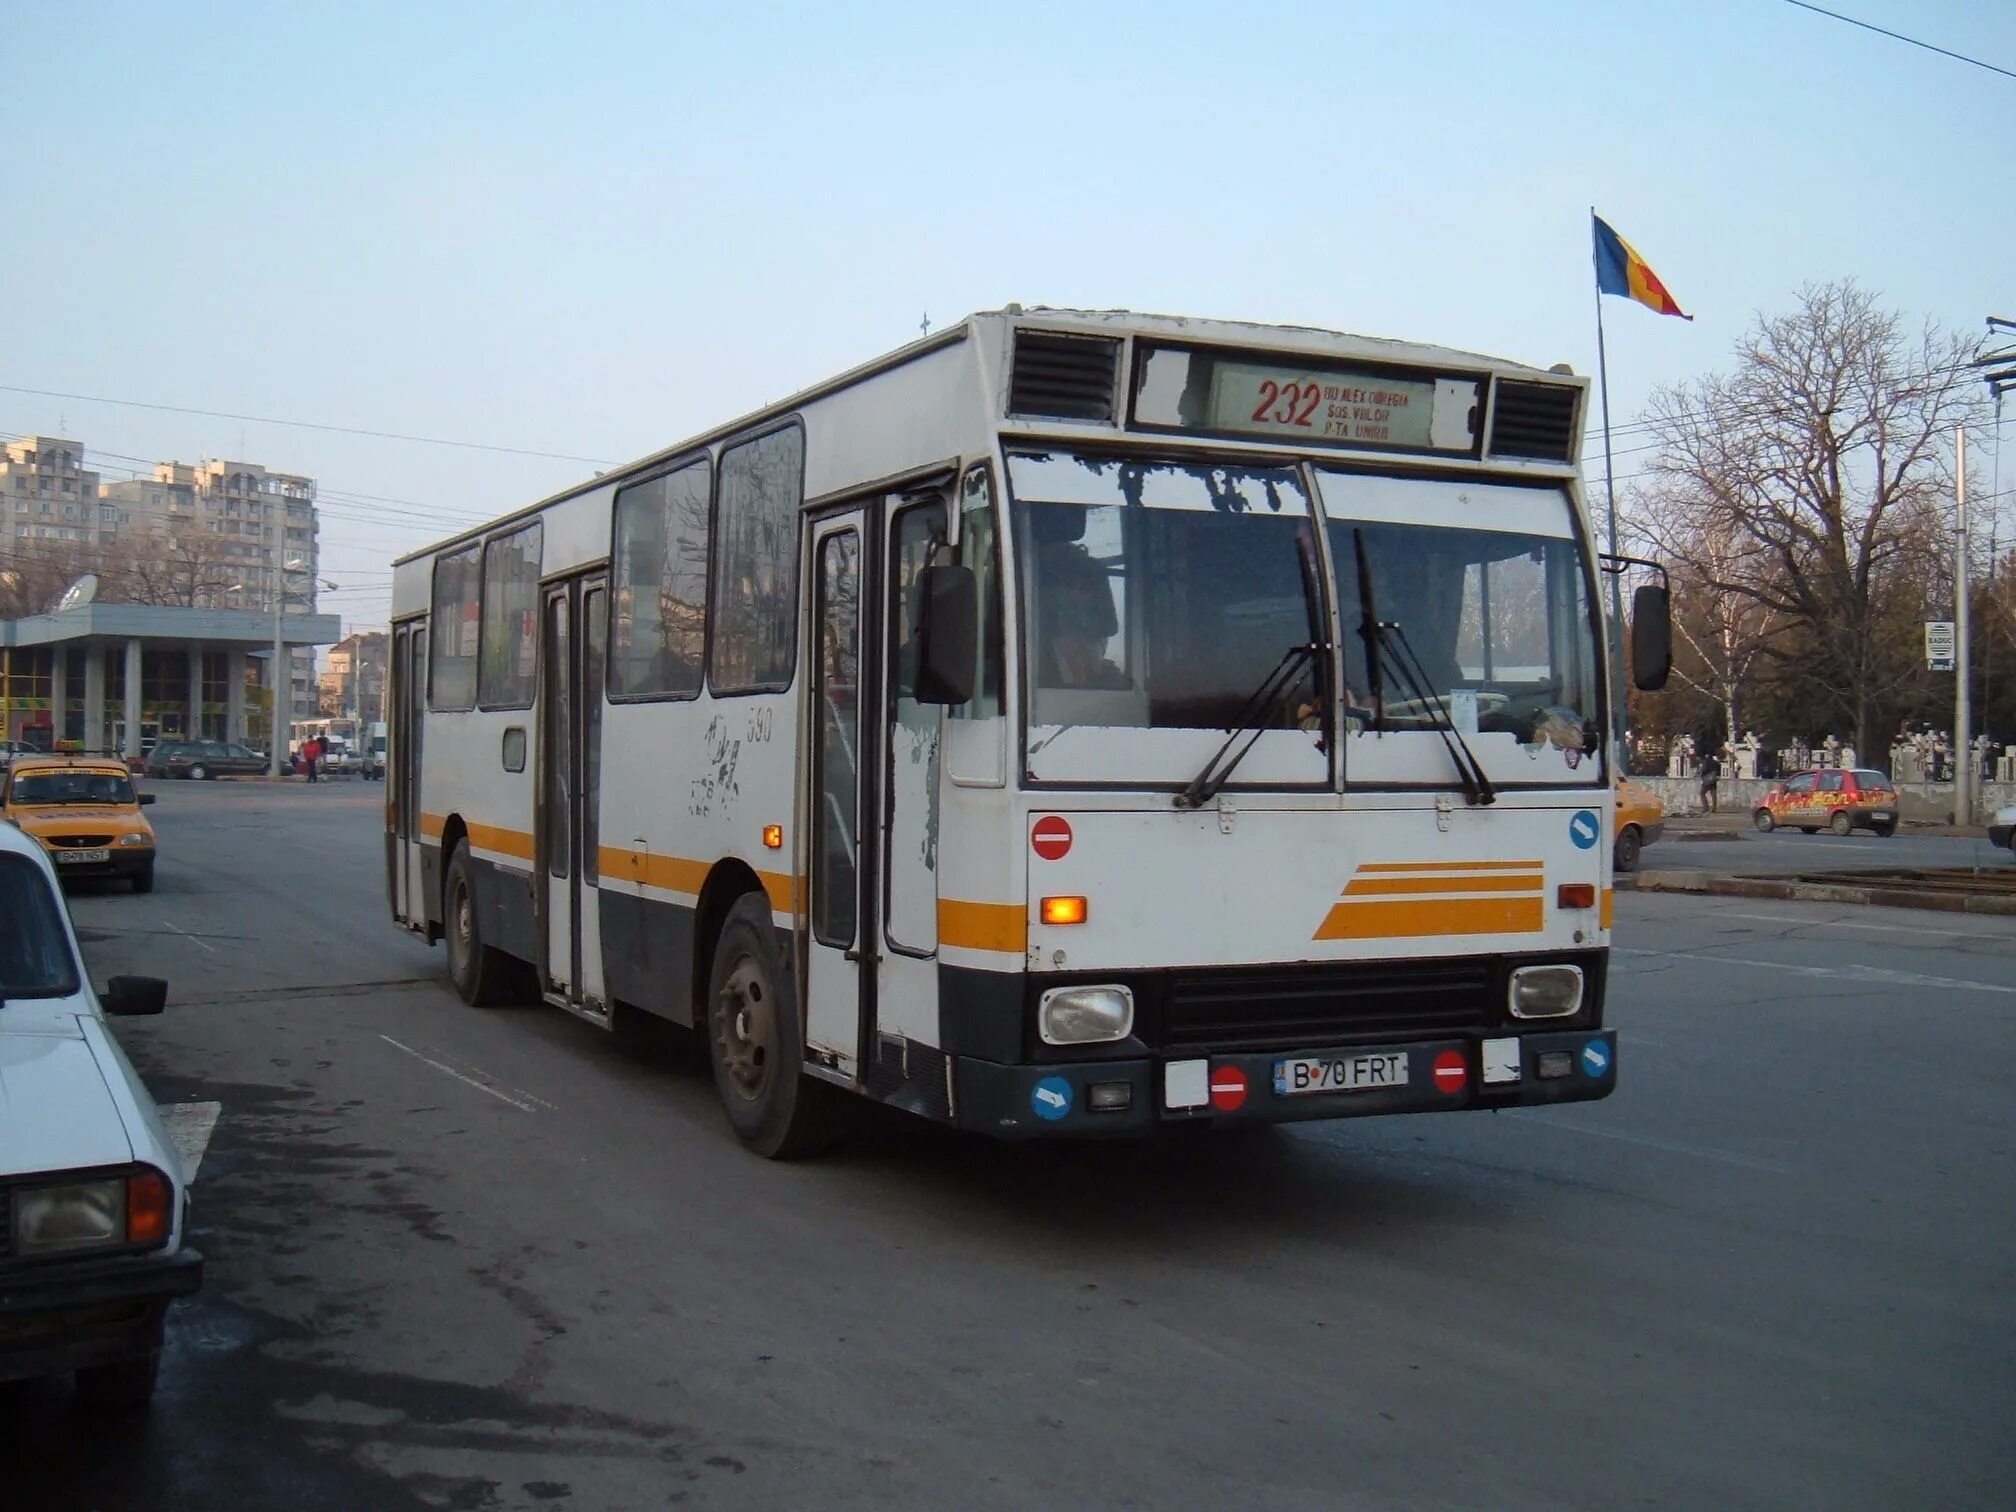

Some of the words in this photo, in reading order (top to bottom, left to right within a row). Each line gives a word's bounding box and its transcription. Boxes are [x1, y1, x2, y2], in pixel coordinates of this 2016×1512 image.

[1252, 380, 1321, 427] 232
[1294, 1062, 1310, 1088] B
[1319, 1060, 1346, 1087] 70
[1354, 1056, 1399, 1084] FRT
